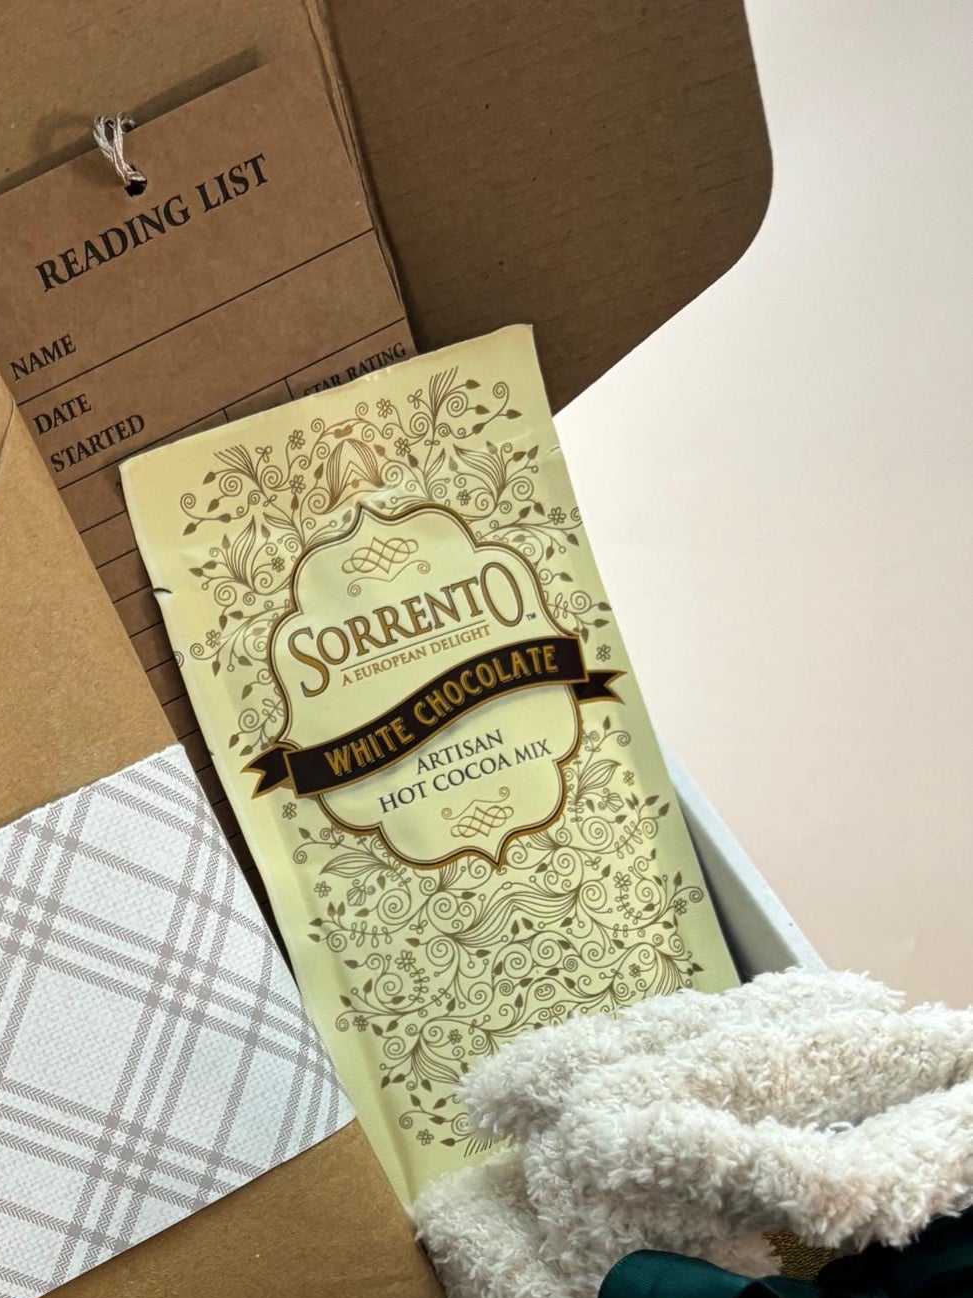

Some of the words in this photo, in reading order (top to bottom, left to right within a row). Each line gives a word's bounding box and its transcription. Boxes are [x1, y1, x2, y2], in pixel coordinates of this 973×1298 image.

[34, 195, 191, 292] READING
[195, 154, 270, 212] LIST
[9, 334, 77, 381] NAME
[345, 342, 406, 381] RATING
[33, 394, 92, 435] DATE
[50, 414, 145, 473] STARTED
[287, 561, 524, 697] SORRENTO
[342, 669, 354, 687] A
[353, 648, 427, 682] EUROPEAN
[427, 624, 492, 656] DELIGHT
[323, 716, 415, 777] WHITE
[413, 644, 558, 725] CHOCOLATE
[379, 781, 427, 813] HOT
[433, 753, 511, 793] COCOA
[514, 740, 552, 764] MIX
[416, 729, 504, 775] ARTISAN
